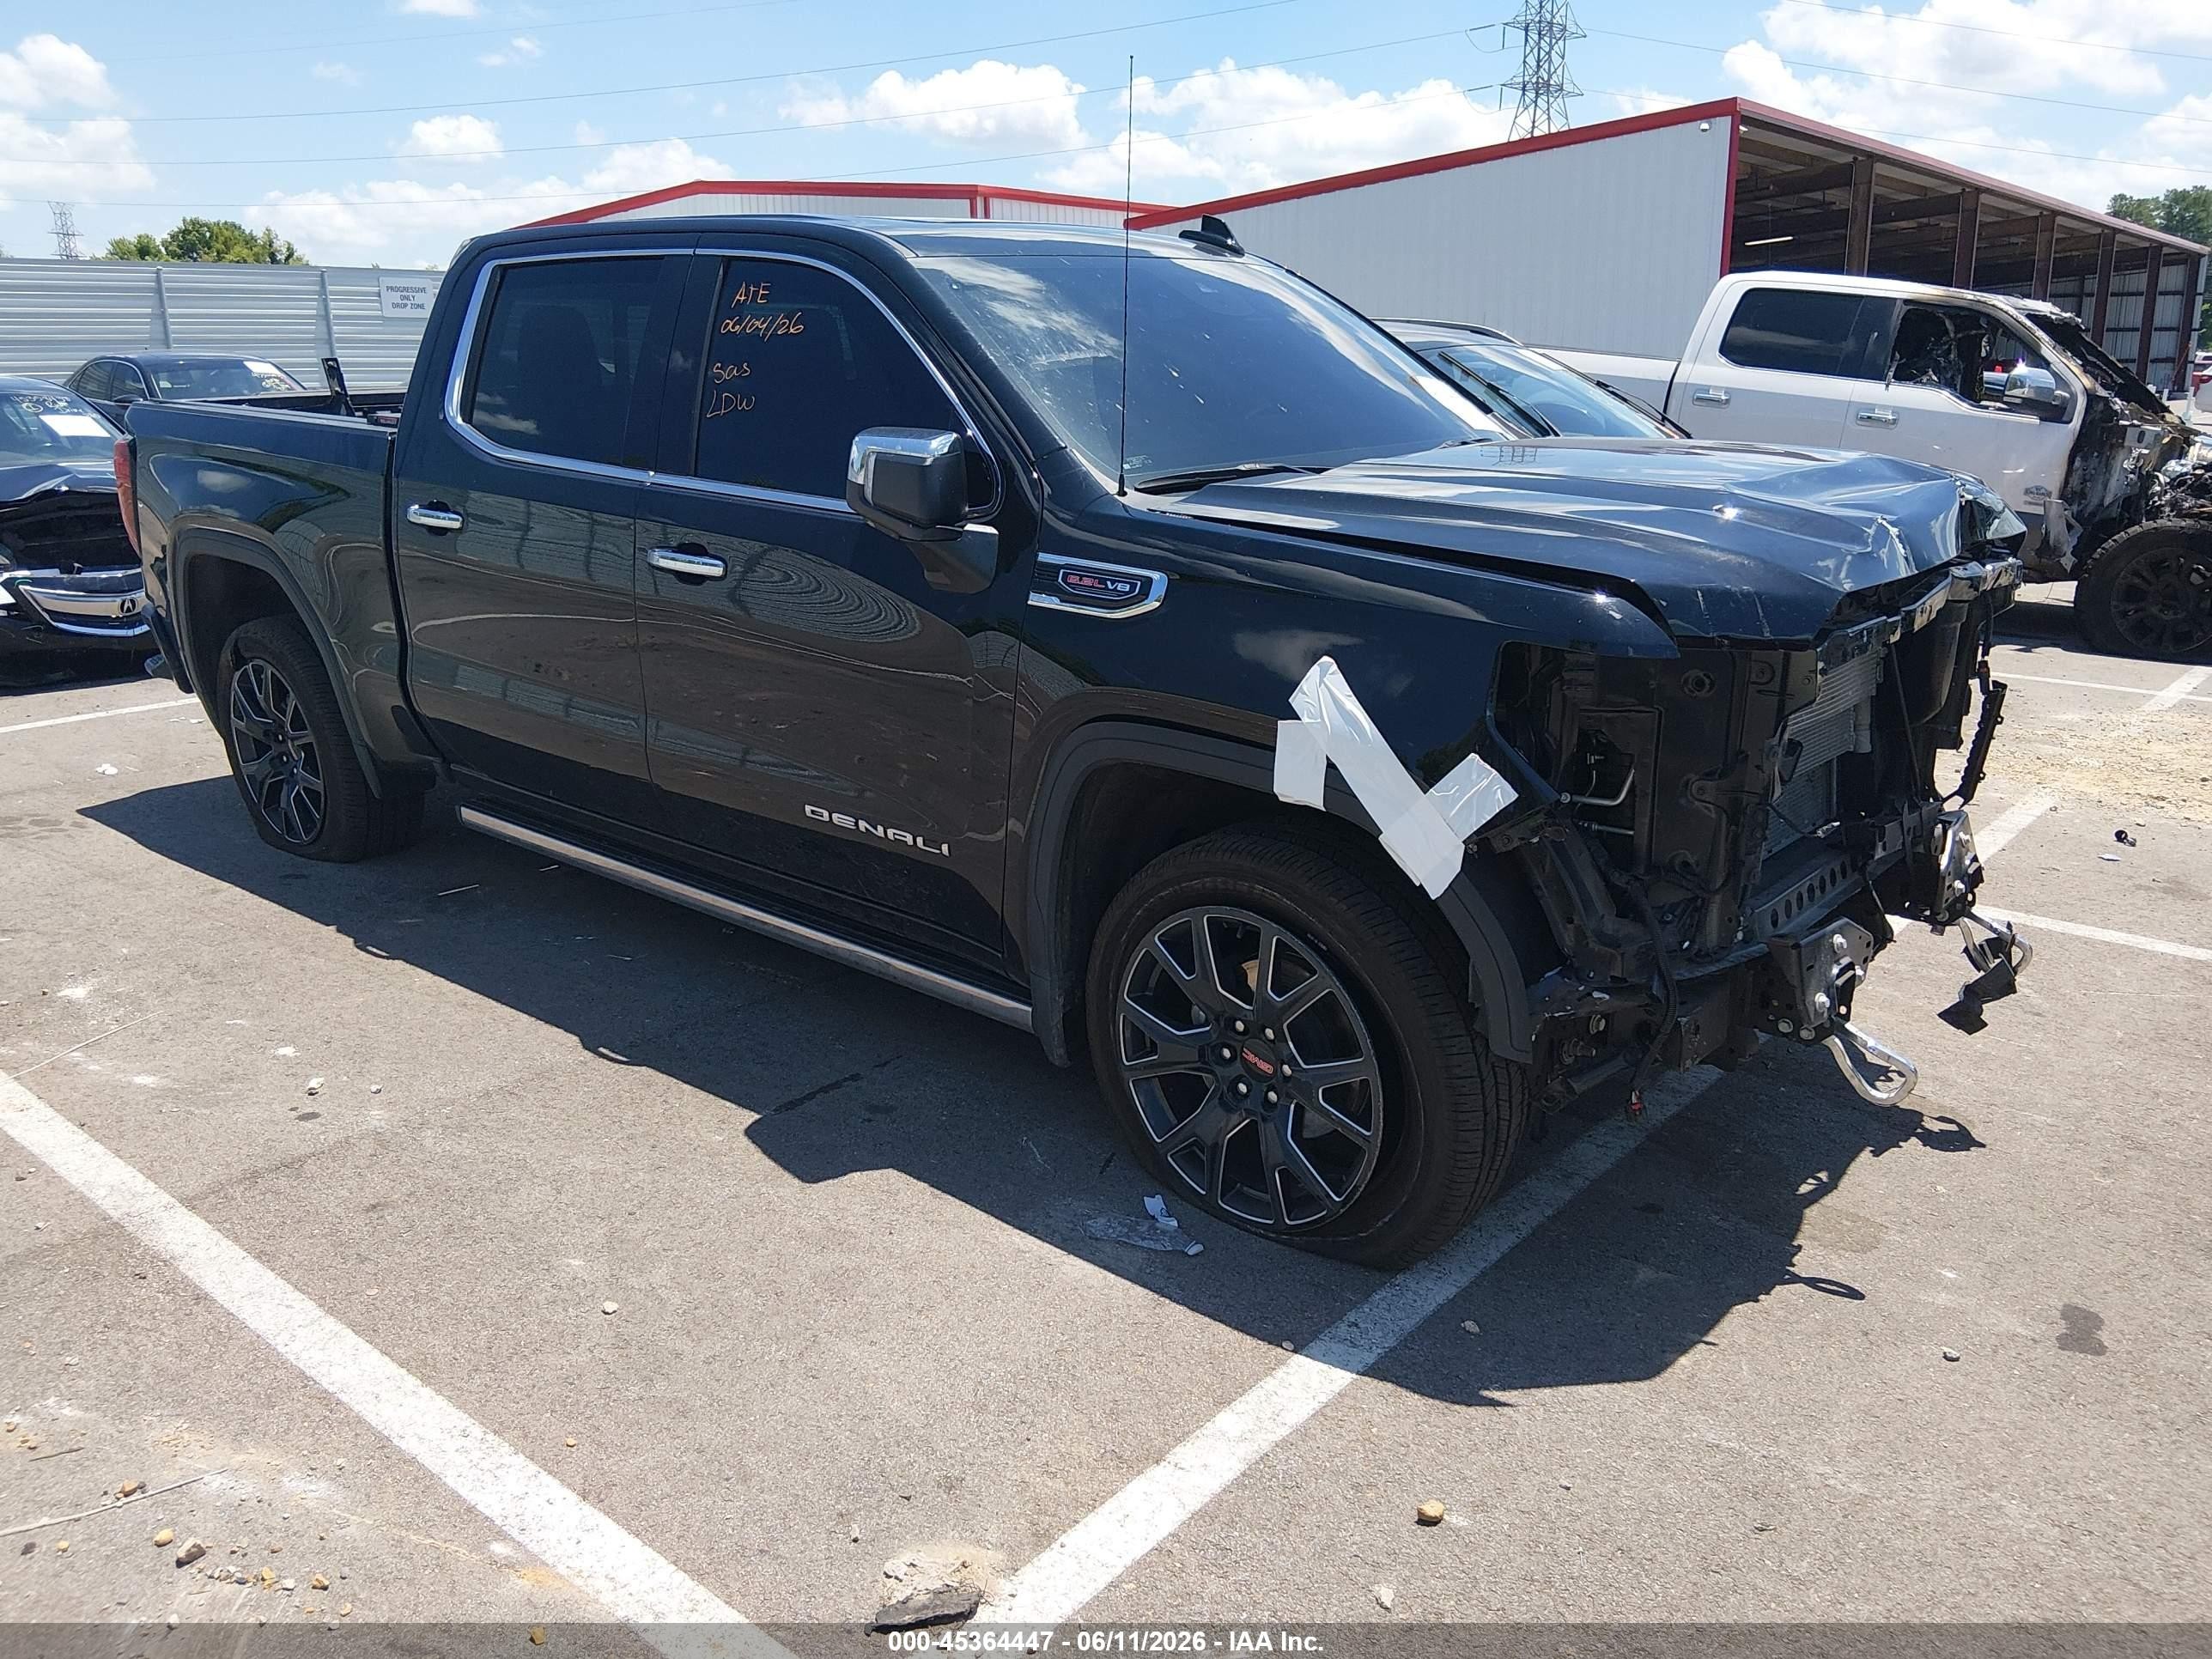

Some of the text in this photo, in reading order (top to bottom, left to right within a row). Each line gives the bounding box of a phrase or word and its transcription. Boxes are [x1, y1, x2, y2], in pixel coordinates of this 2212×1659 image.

[386, 285, 427, 294] PROGRESSIVE
[392, 301, 409, 310] DROP
[720, 312, 805, 343] 06/04/26
[1106, 580, 1130, 592] V8
[804, 804, 951, 857] DENALI
[1242, 1047, 1274, 1074] GMC
